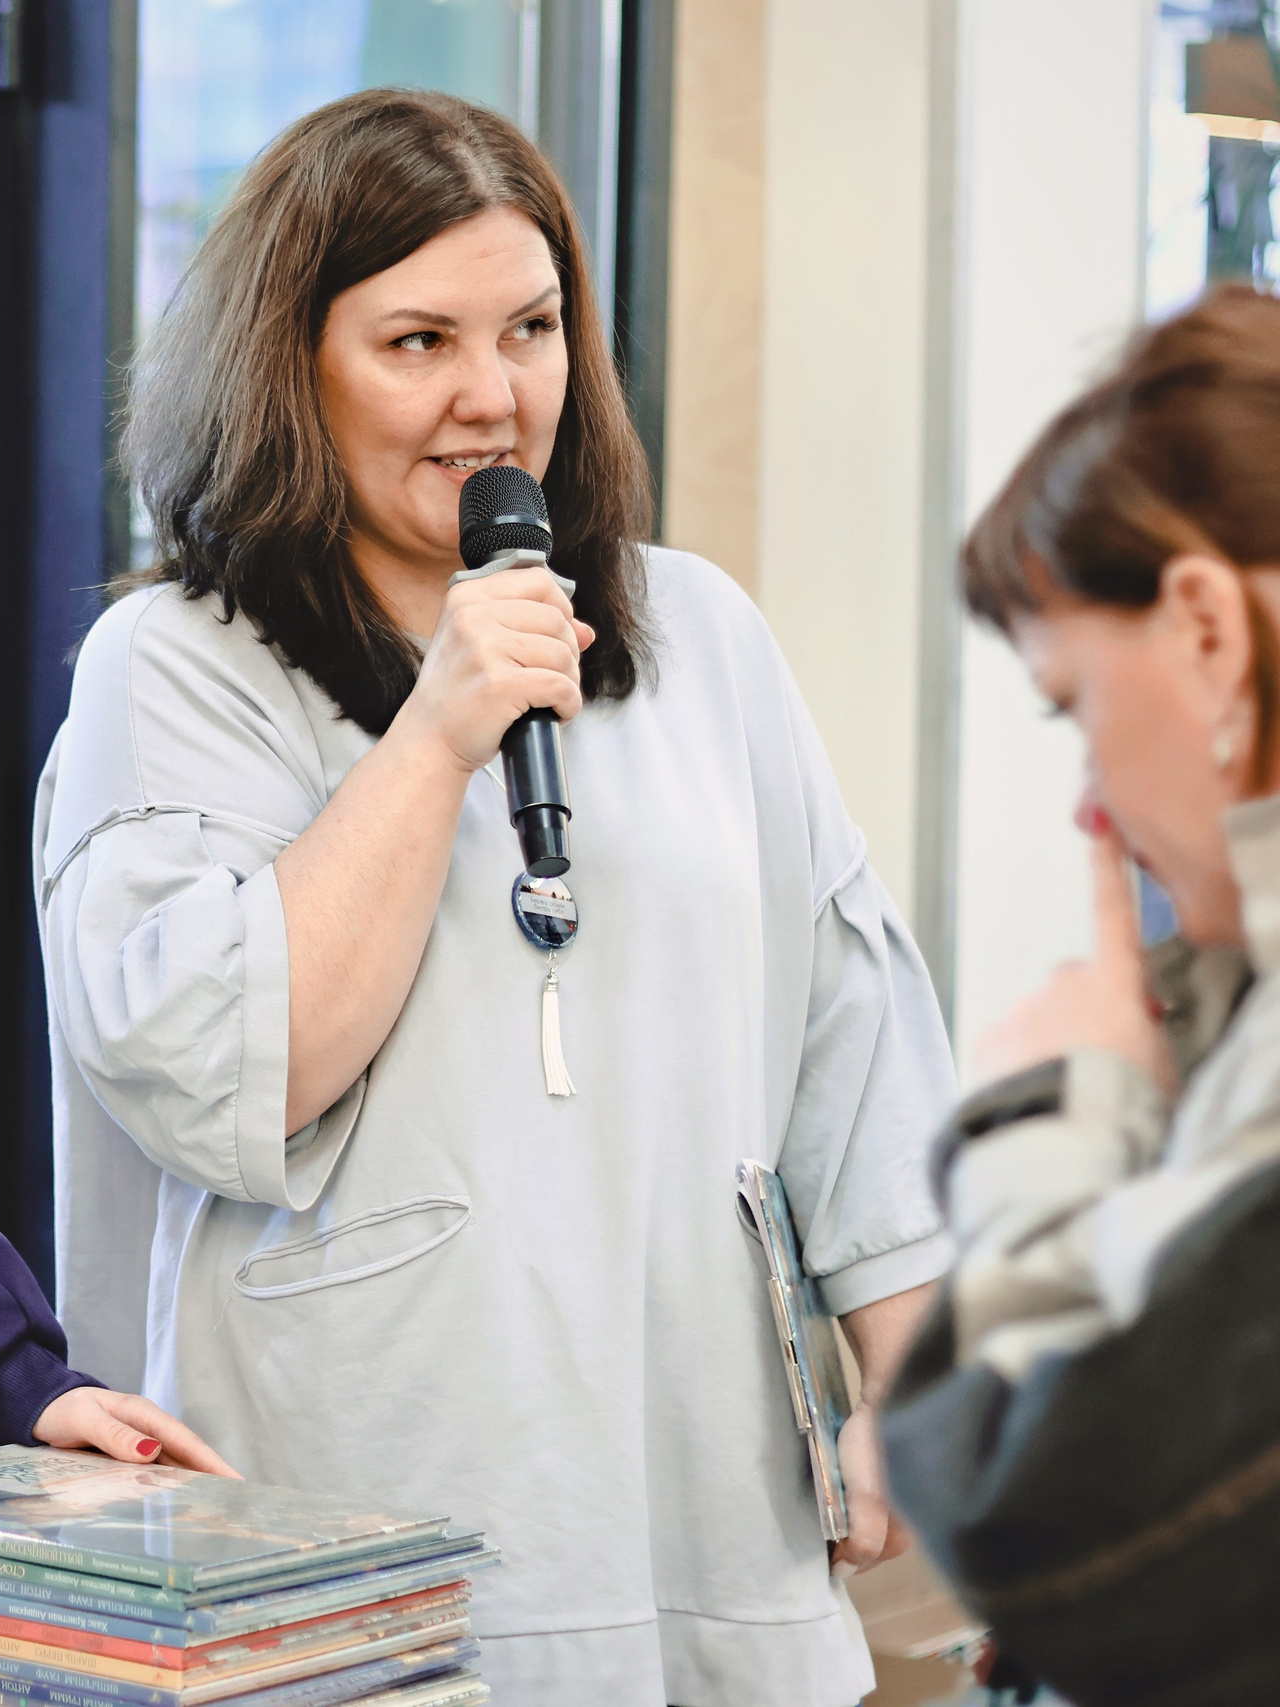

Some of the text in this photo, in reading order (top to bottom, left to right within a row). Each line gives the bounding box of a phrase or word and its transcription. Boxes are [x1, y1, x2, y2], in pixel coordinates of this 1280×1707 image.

[45, 1572, 80, 1588] Андерсен
[81, 1579, 116, 1595] Кристиан
[20, 1584, 52, 1600] АНТОН
[68, 1593, 93, 1605] ГАУФ
[9, 1605, 47, 1620] Андерсен
[98, 1599, 153, 1619] ВИЛЬГЕЛЬМ
[48, 1613, 86, 1629] Кристиан
[87, 1621, 108, 1633] Ханс
[34, 1647, 63, 1662] ПЕРРО
[65, 1653, 96, 1669] ШАРЛЬ
[35, 1668, 60, 1683] ГАУФ
[1, 1680, 31, 1695] АНТОН
[65, 1674, 119, 1695] ВИЛЬГЕЛЬМ
[49, 1690, 81, 1706] ГРИММ
